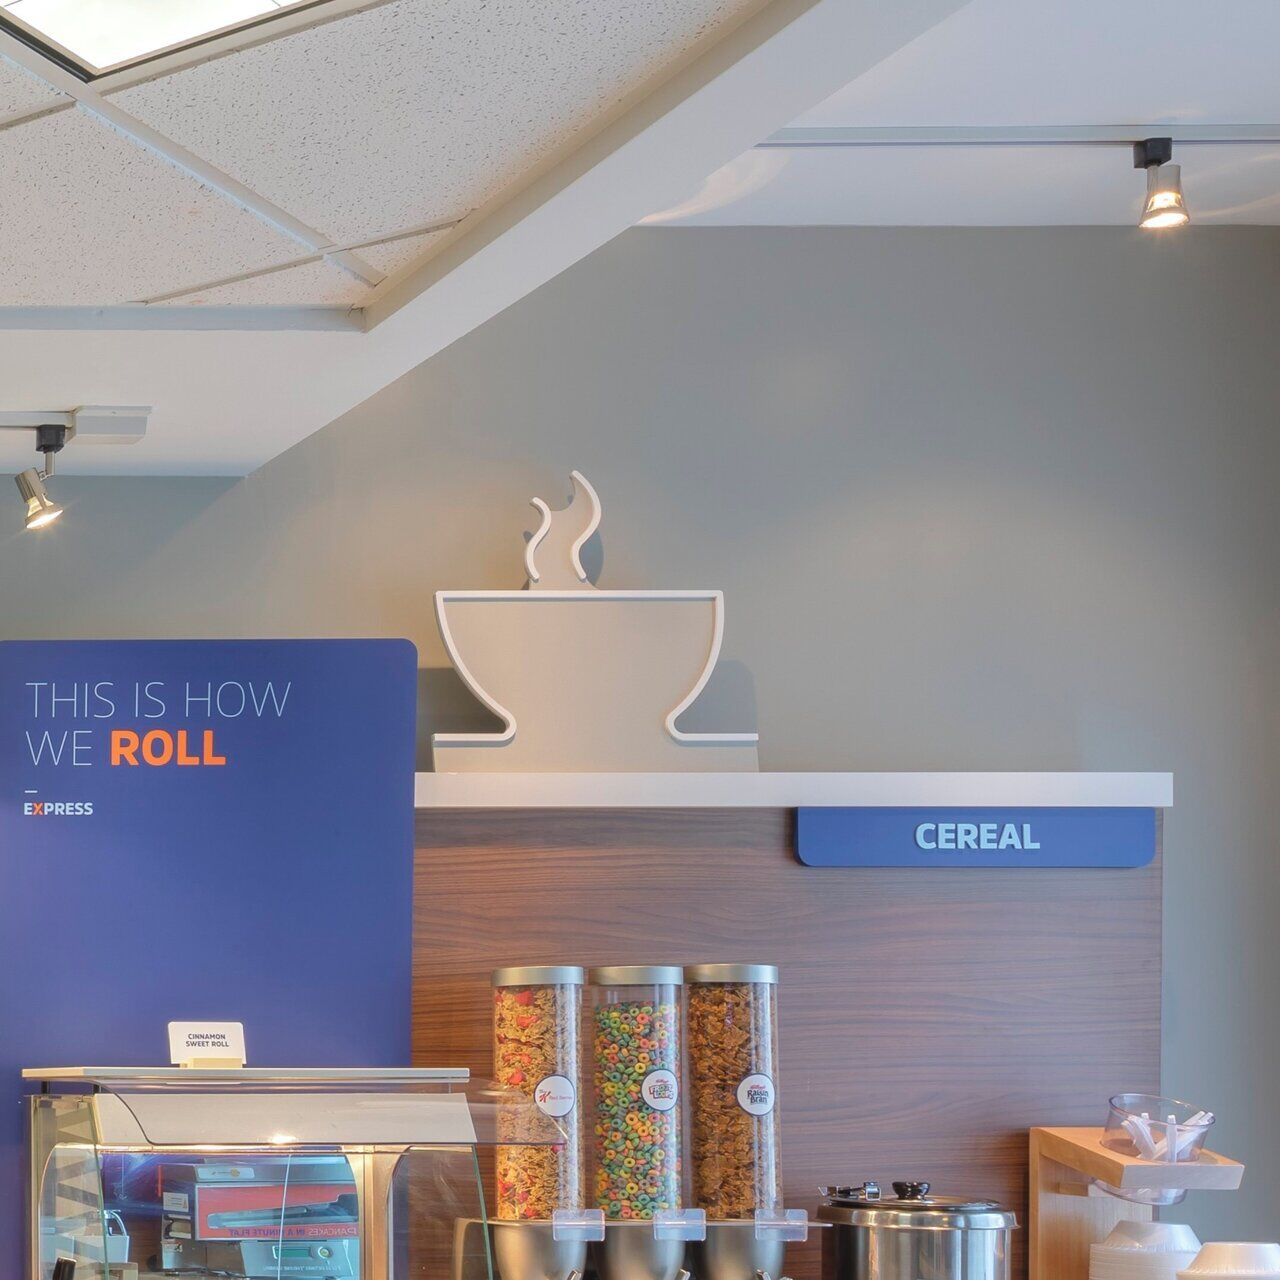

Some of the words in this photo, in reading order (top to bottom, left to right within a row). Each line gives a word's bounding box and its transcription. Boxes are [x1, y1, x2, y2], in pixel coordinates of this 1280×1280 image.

[25, 681, 116, 718] THIS
[134, 681, 166, 718] IS
[185, 681, 292, 718] HOW
[25, 730, 93, 766] WE
[110, 729, 226, 767] ROLL
[24, 802, 93, 816] EXPRESS
[915, 822, 1040, 850] CEREAL
[747, 1090, 769, 1098] Raisin
